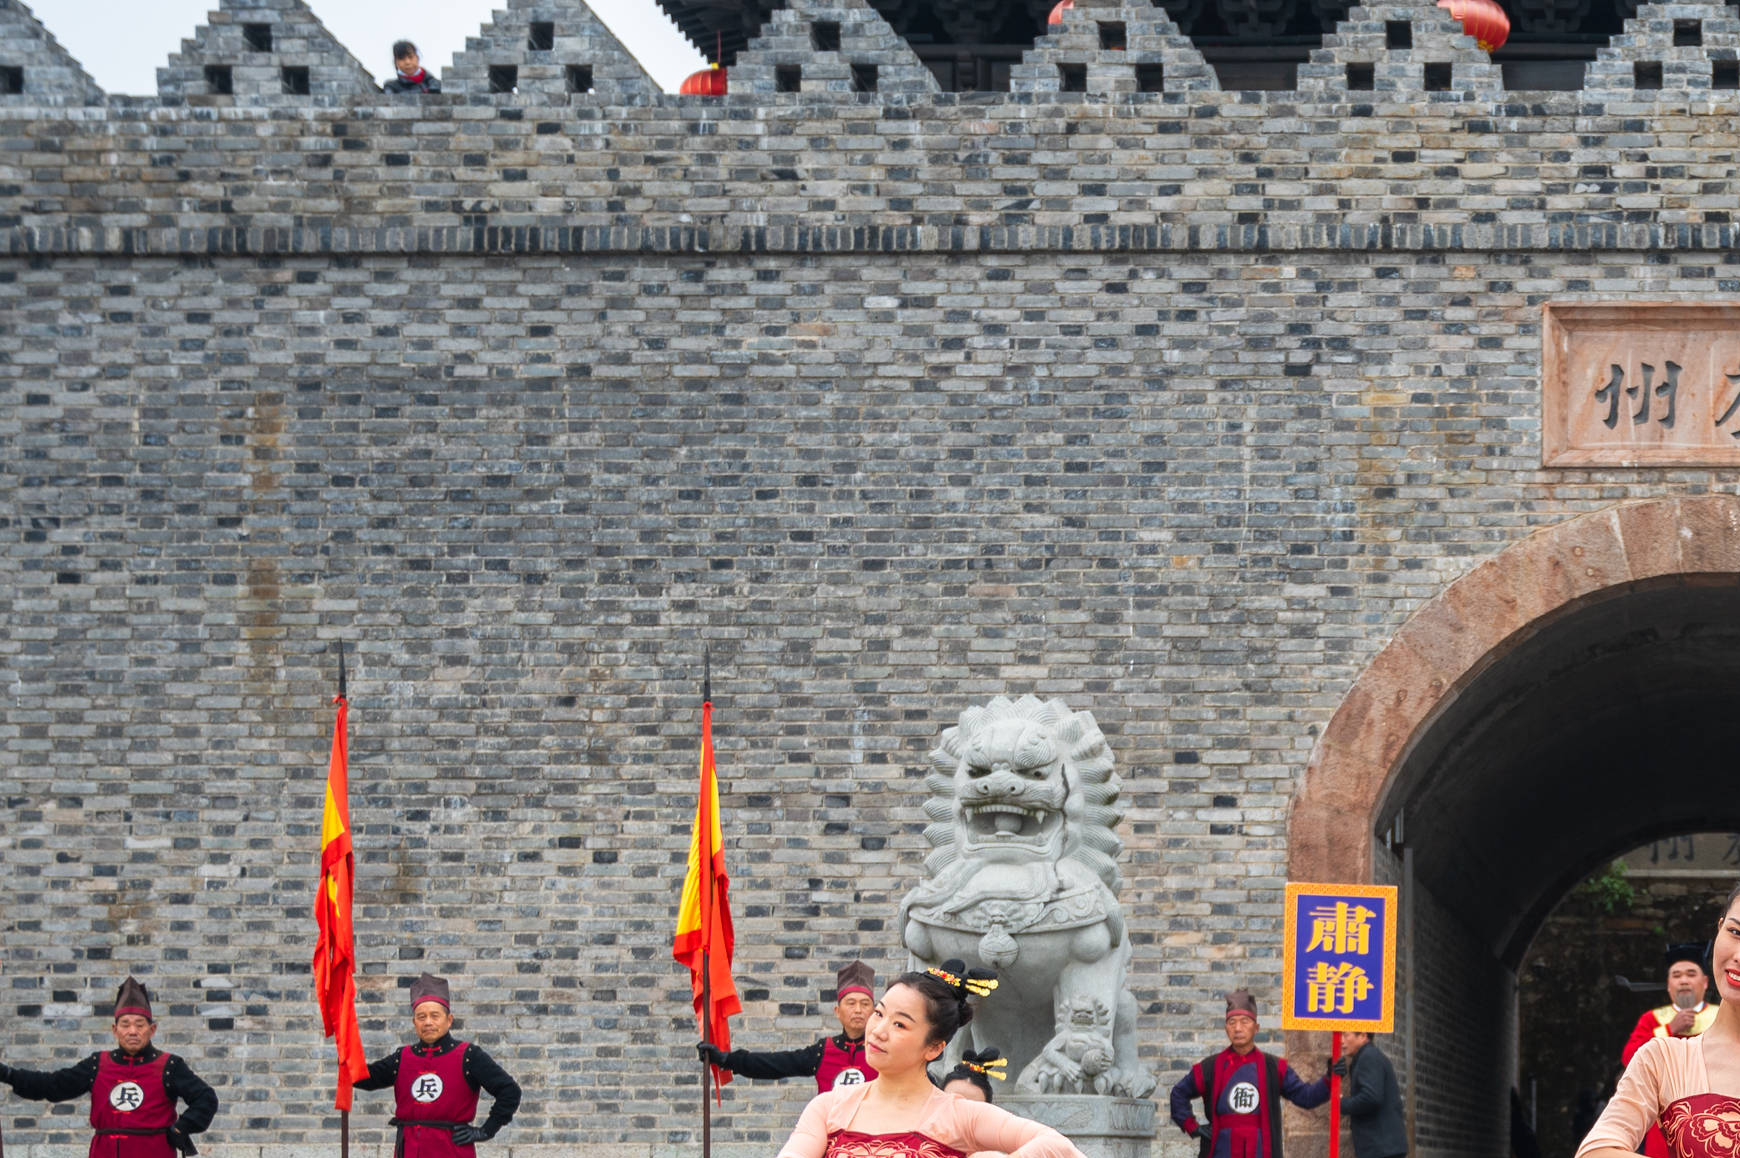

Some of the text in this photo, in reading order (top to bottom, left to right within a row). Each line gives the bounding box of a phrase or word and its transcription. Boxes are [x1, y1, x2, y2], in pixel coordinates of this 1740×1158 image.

[116, 1086, 140, 1108] 兵
[416, 1077, 438, 1099] 兵
[1232, 1086, 1256, 1109] 衙
